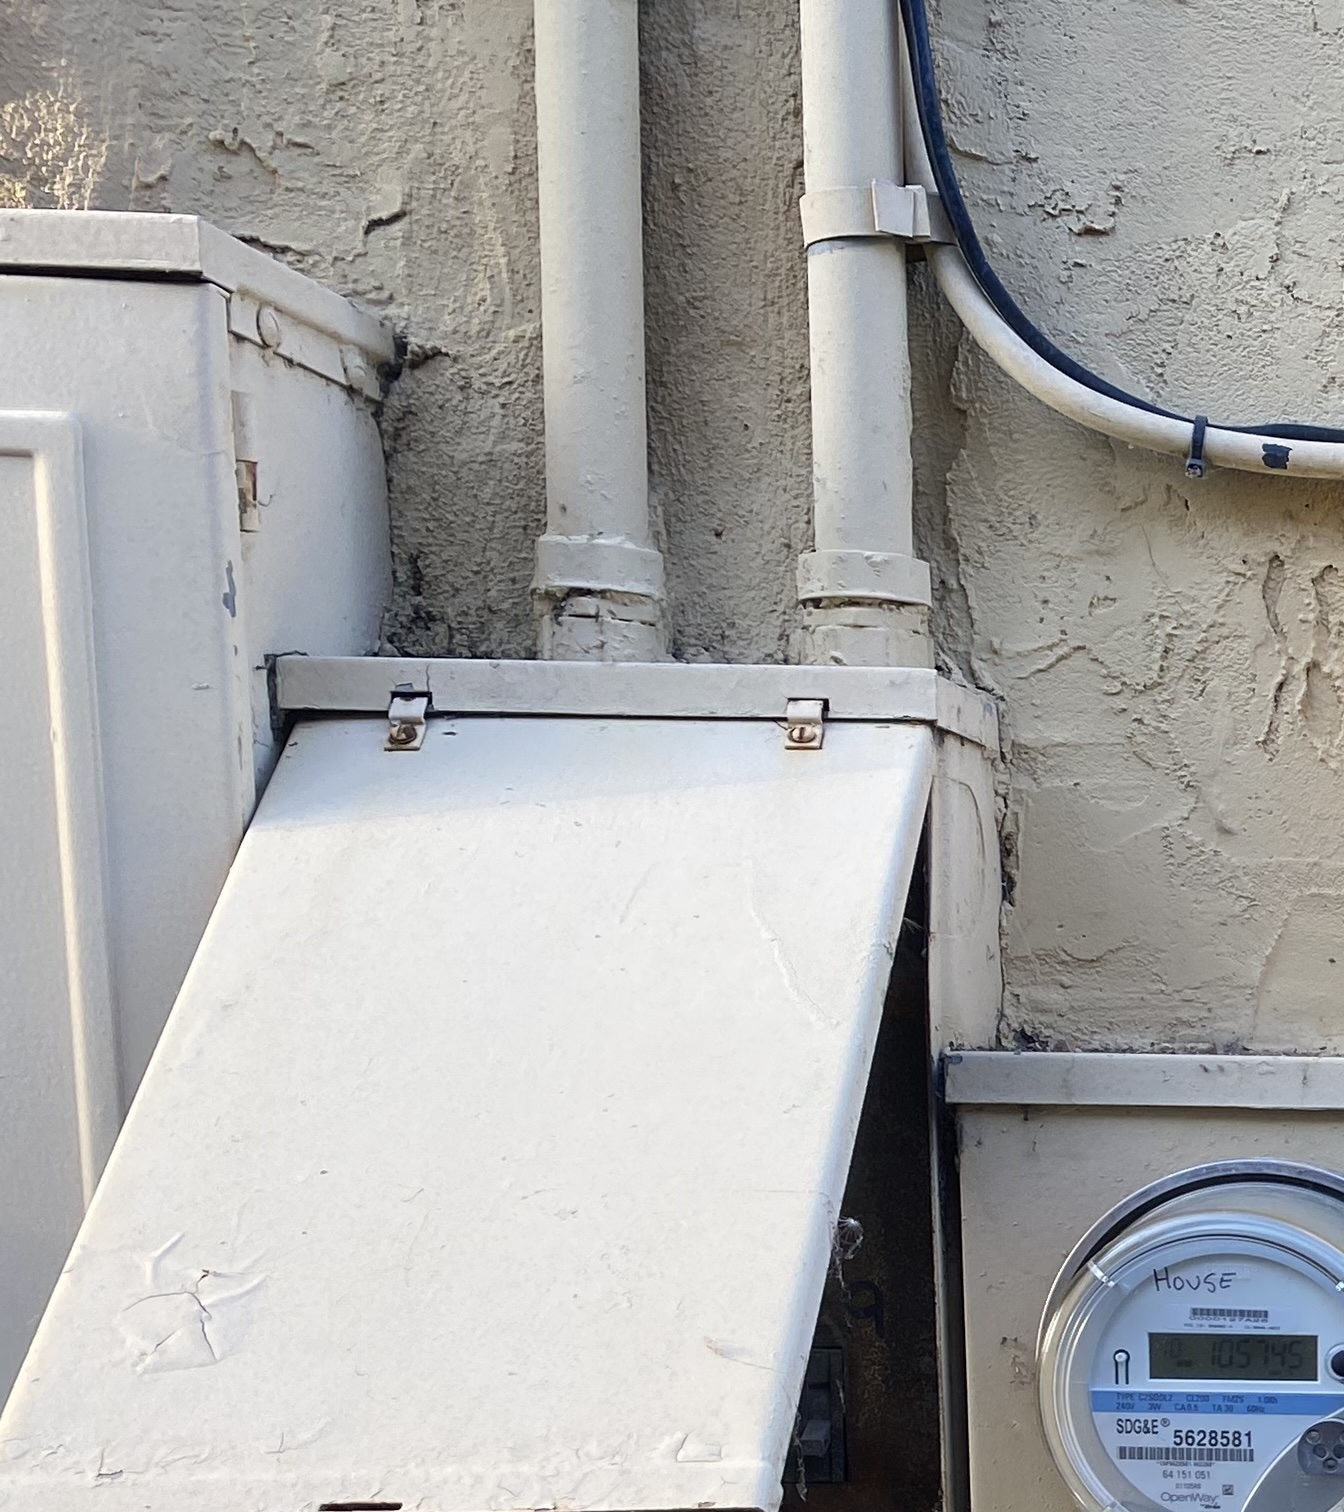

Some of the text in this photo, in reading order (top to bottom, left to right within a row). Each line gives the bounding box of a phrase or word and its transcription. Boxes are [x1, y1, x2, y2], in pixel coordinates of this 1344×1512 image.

[1152, 1266, 1237, 1294] HOUSE
[1172, 1429, 1254, 1448] 5628581
[1160, 1492, 1219, 1504] OpenWay
